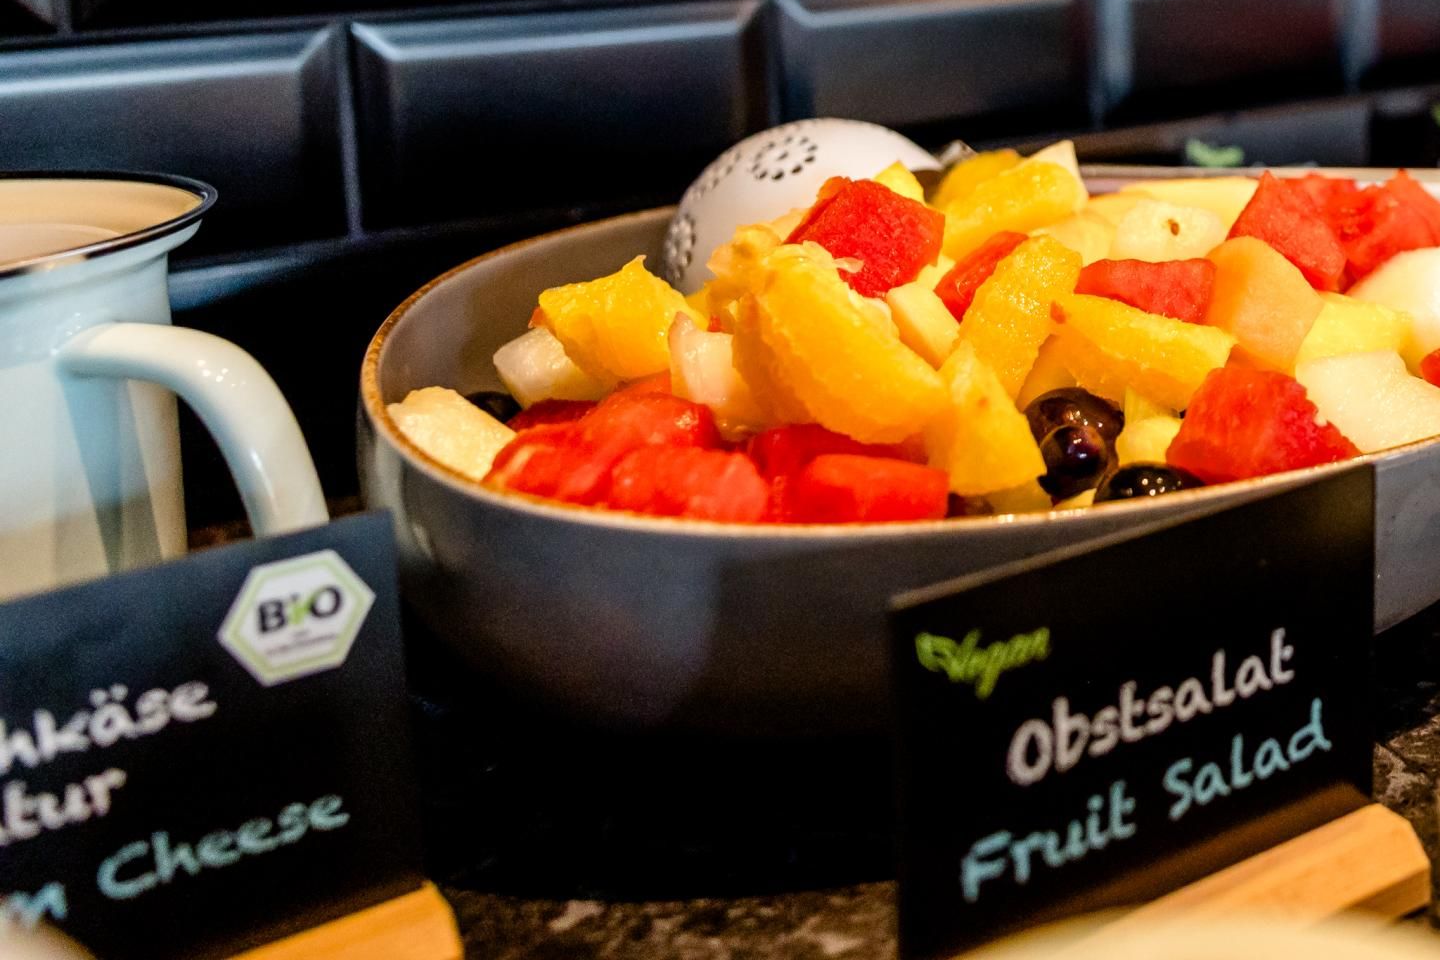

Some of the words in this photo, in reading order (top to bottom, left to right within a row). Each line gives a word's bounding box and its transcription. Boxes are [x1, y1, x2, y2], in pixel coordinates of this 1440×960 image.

[1007, 627, 1294, 786] Obstsalat
[0, 767, 127, 844] tur
[97, 794, 350, 899] Cheese
[961, 780, 1136, 902] Fruit
[1163, 698, 1332, 821] Salad
